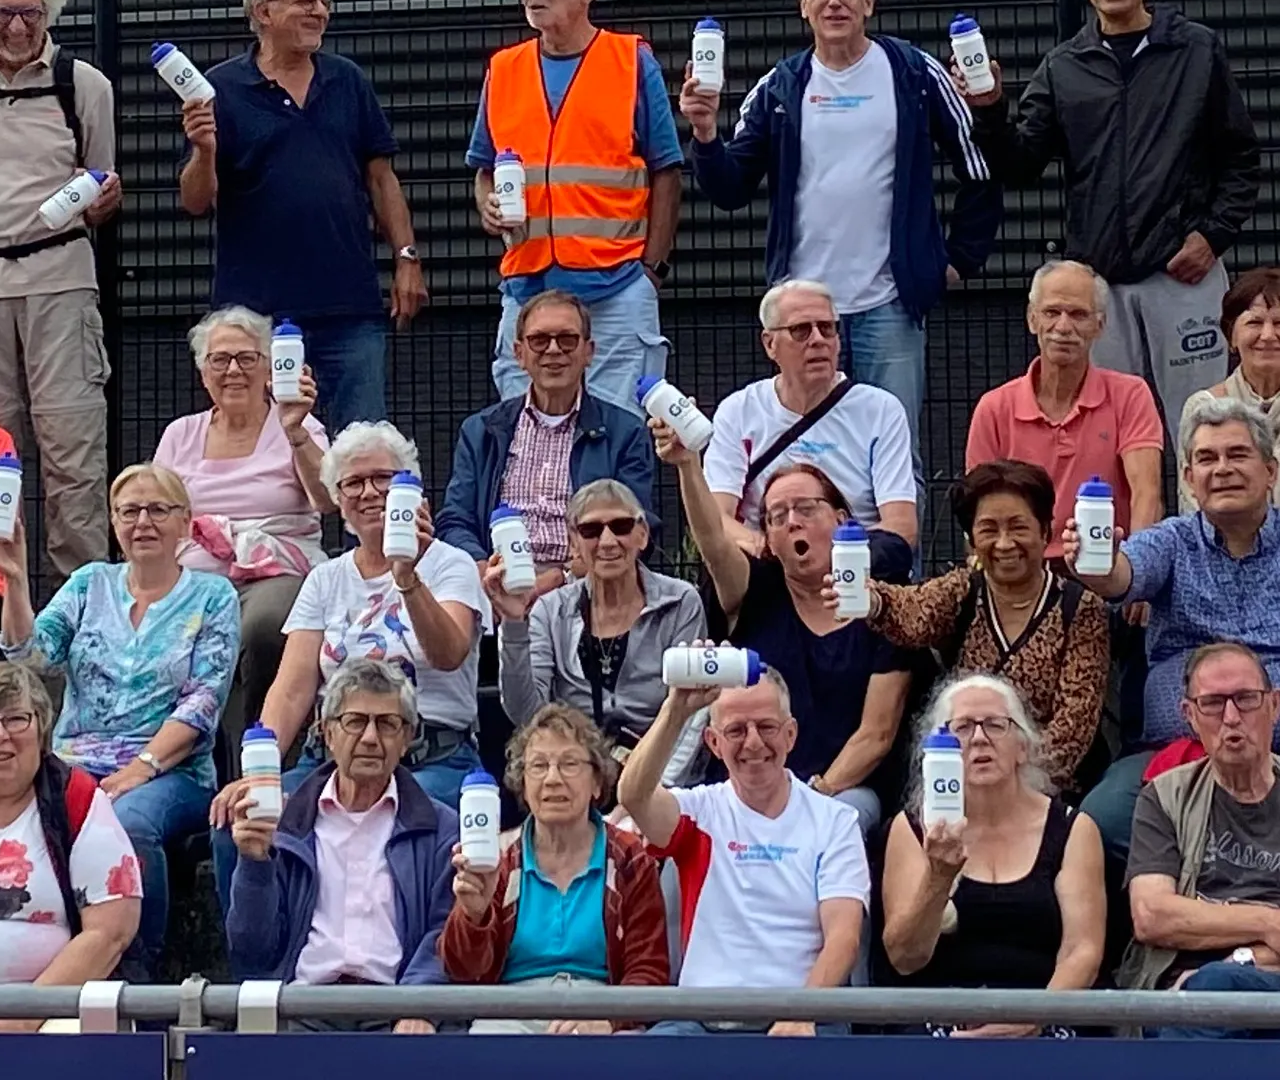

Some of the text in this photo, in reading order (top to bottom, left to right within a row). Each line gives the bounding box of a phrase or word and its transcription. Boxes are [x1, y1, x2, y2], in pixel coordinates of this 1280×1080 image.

[962, 52, 984, 67] GO
[174, 67, 194, 86] GO
[274, 357, 295, 371] GO
[390, 508, 414, 522] GO
[933, 778, 961, 794] GO
[463, 813, 489, 828] GO
